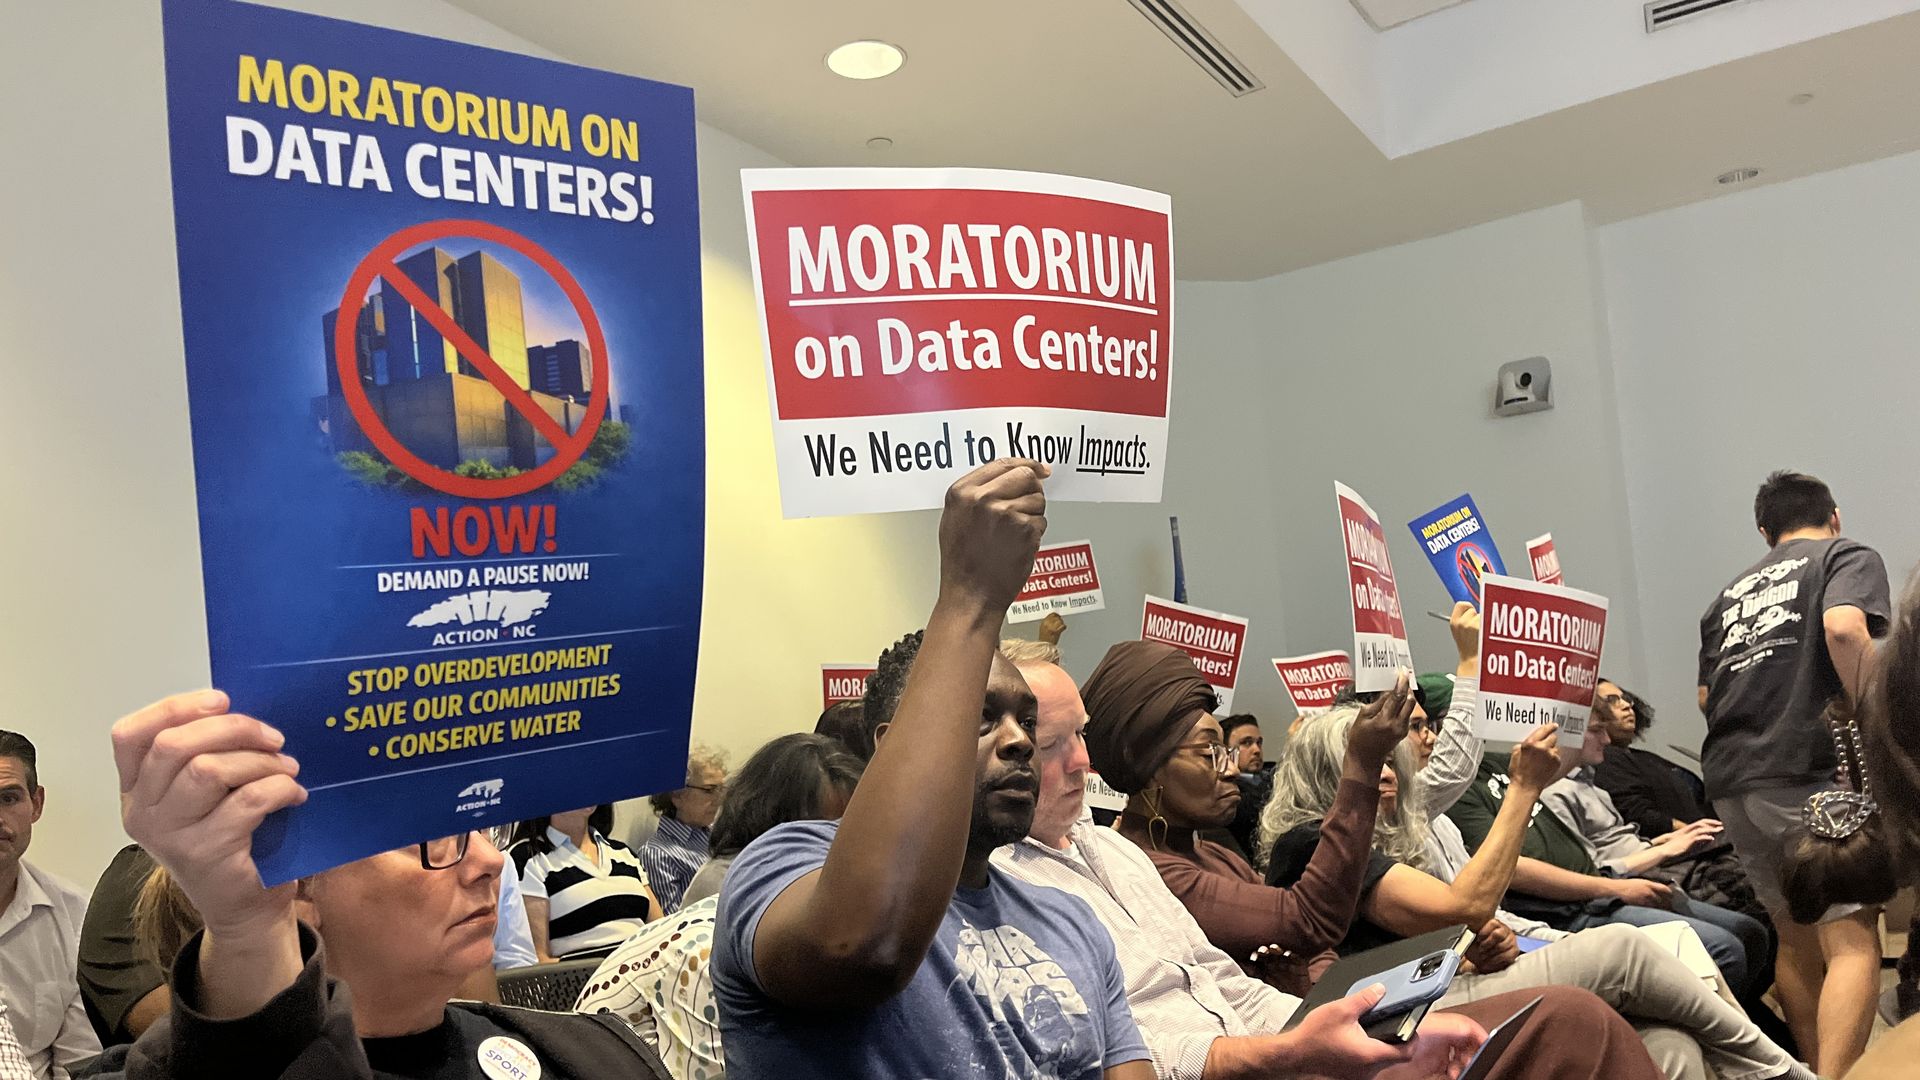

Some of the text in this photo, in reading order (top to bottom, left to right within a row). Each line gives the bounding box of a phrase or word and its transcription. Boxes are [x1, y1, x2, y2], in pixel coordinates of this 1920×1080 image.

[237, 54, 639, 161] MORATORIUM ON
[226, 115, 655, 225] DATA CENTERS!
[788, 223, 1157, 304] MORATORIUM
[794, 314, 1158, 382] on Data Centers!
[804, 422, 1151, 478] We Need to Know Impacts.
[410, 504, 558, 559] NOW!
[1421, 505, 1473, 540] MORATORIUM ON
[1426, 517, 1481, 555] DATA CENTERS!
[377, 562, 589, 593] DEMAND A PAUSE NOW!
[1032, 551, 1089, 574] ATORIUM
[1048, 570, 1093, 589] Centers!
[1355, 583, 1369, 610] on
[432, 625, 536, 646] ACTION NC
[1146, 613, 1238, 654] MORATORIUM
[1489, 602, 1602, 653] MORATORIUM
[347, 643, 612, 696] STOP OVERDEVELOPMENT
[1191, 656, 1233, 677] nters!
[1487, 650, 1597, 689] on Data Centers!
[344, 673, 621, 732] SAVE OUR COMMUNITIES
[1293, 690, 1307, 700] on
[1304, 687, 1332, 701] Data
[1485, 699, 1502, 721] We
[1506, 702, 1536, 725] Need
[386, 709, 582, 760] CONSERVE WATER
[456, 800, 486, 813] ACTION
[485, 1049, 528, 1080] SPORT
